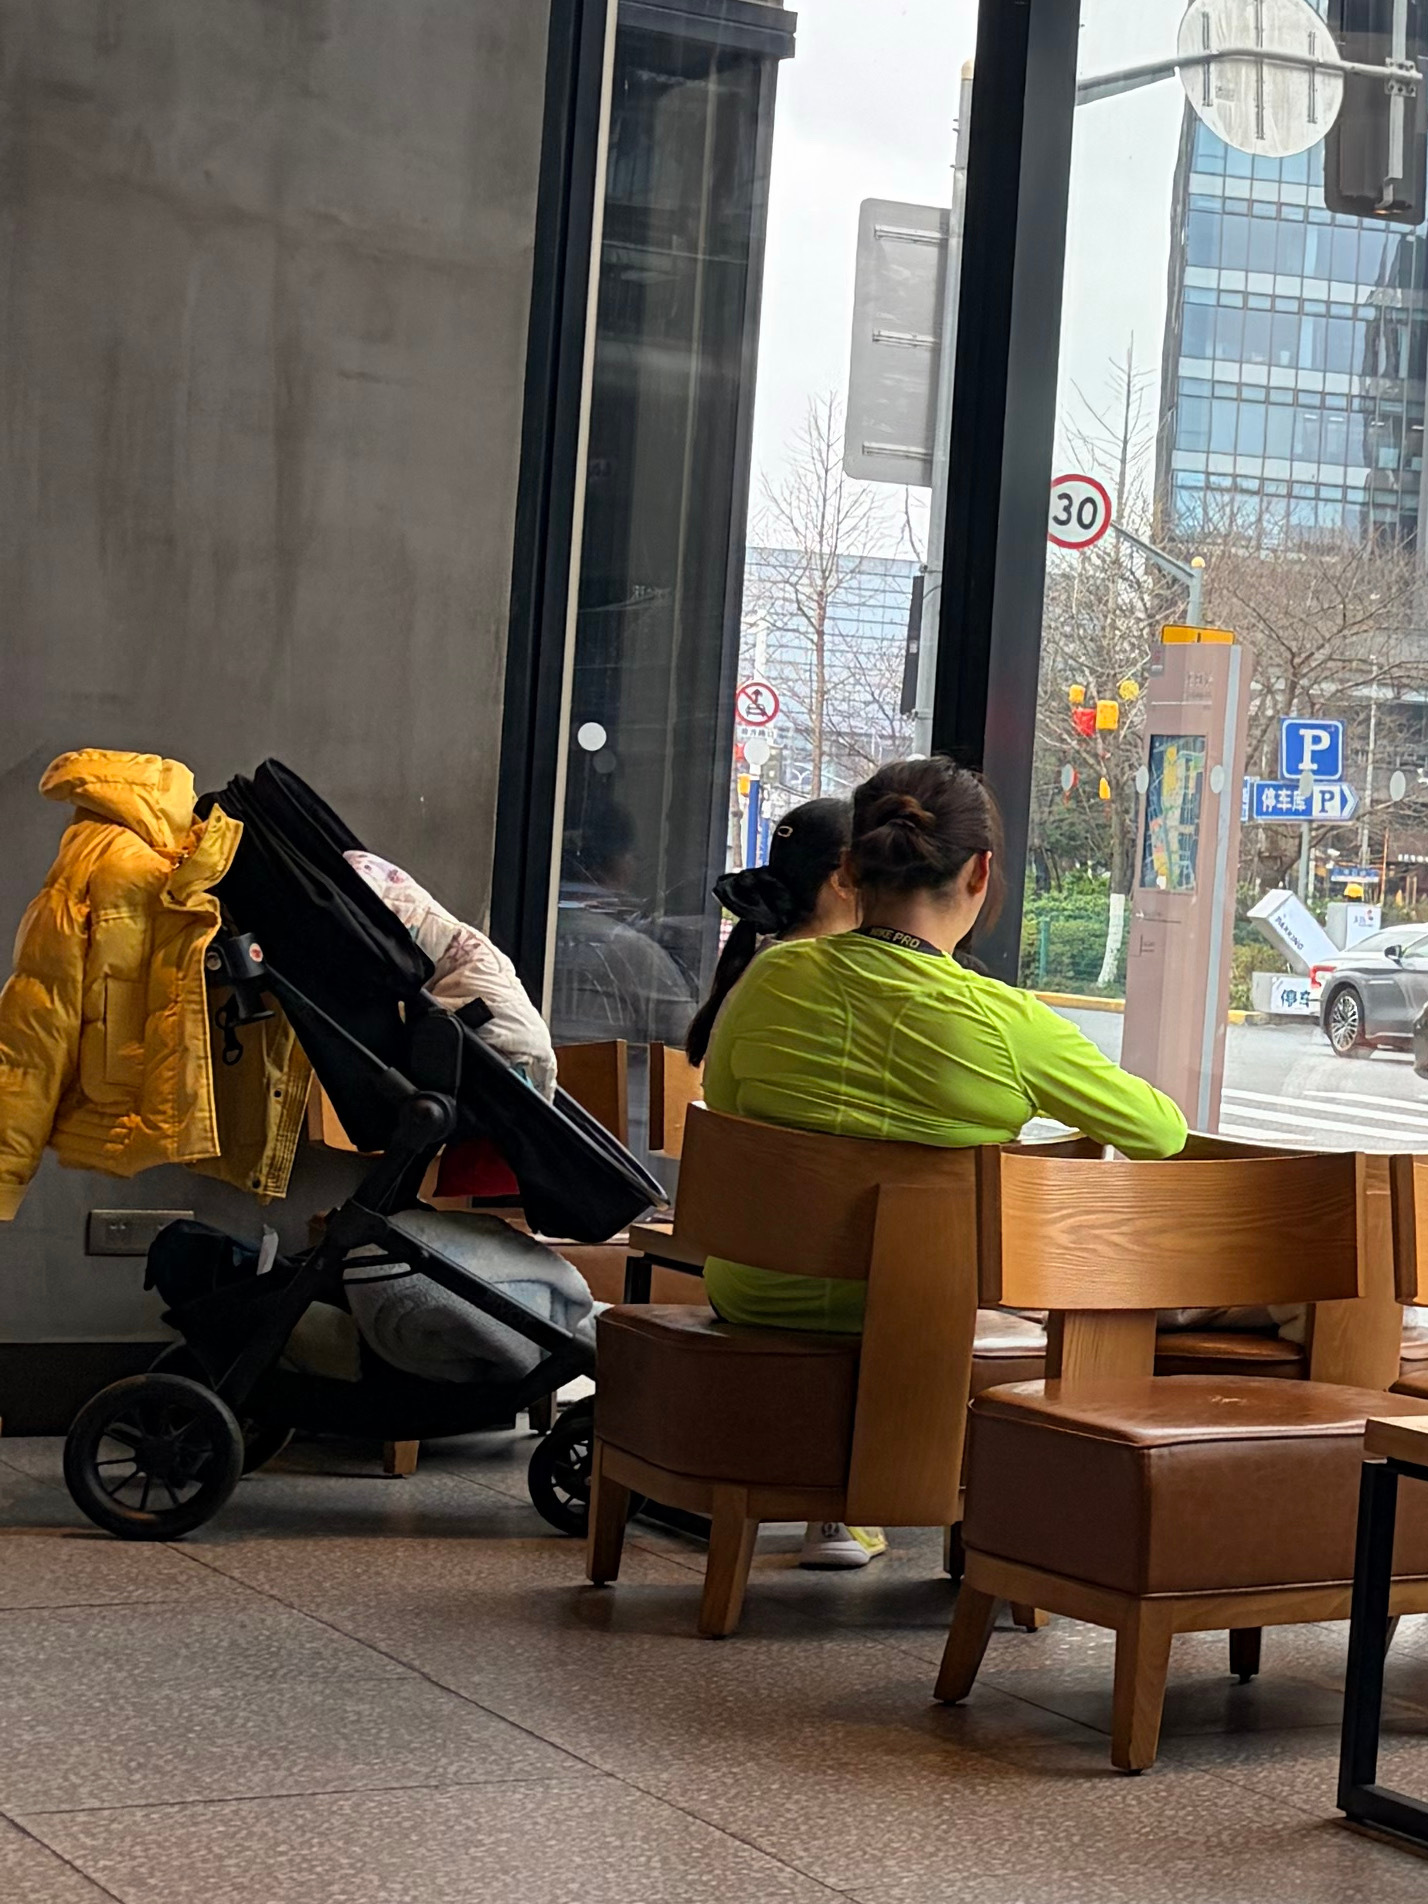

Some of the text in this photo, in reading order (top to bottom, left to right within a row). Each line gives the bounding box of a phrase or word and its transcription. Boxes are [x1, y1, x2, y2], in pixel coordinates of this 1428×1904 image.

[1052, 492, 1098, 530] 30
[1298, 728, 1331, 770] P
[1319, 790, 1336, 813] P
[892, 932, 921, 948] PRO
